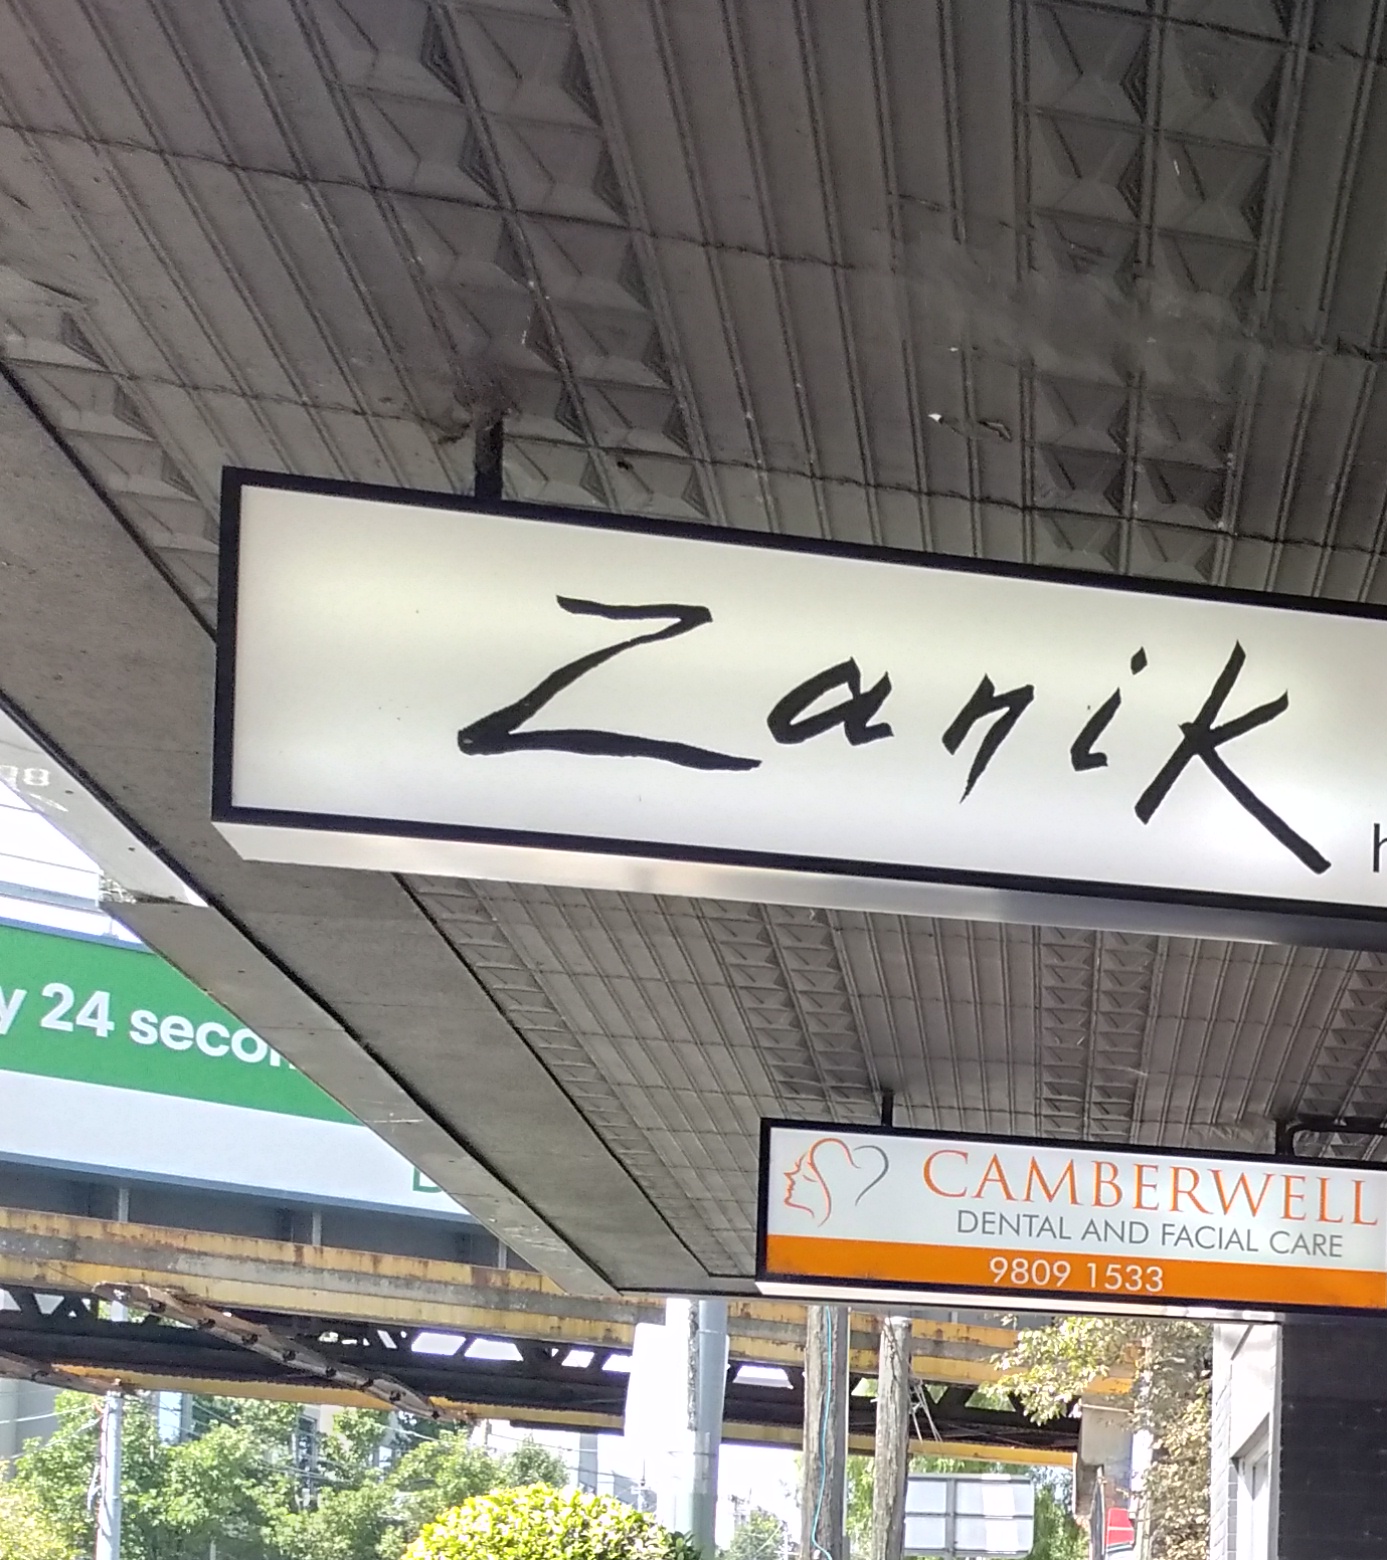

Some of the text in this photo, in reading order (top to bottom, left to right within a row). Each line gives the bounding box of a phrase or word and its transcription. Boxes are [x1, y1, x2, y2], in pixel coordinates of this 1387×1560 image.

[459, 594, 1332, 874] Zanik
[40, 982, 114, 1038] 24
[923, 1149, 1378, 1227] CAMBERWELL
[957, 1209, 1343, 1259] DENTAL AND FACIAL CARE
[989, 1256, 1163, 1293] 9809 1533
